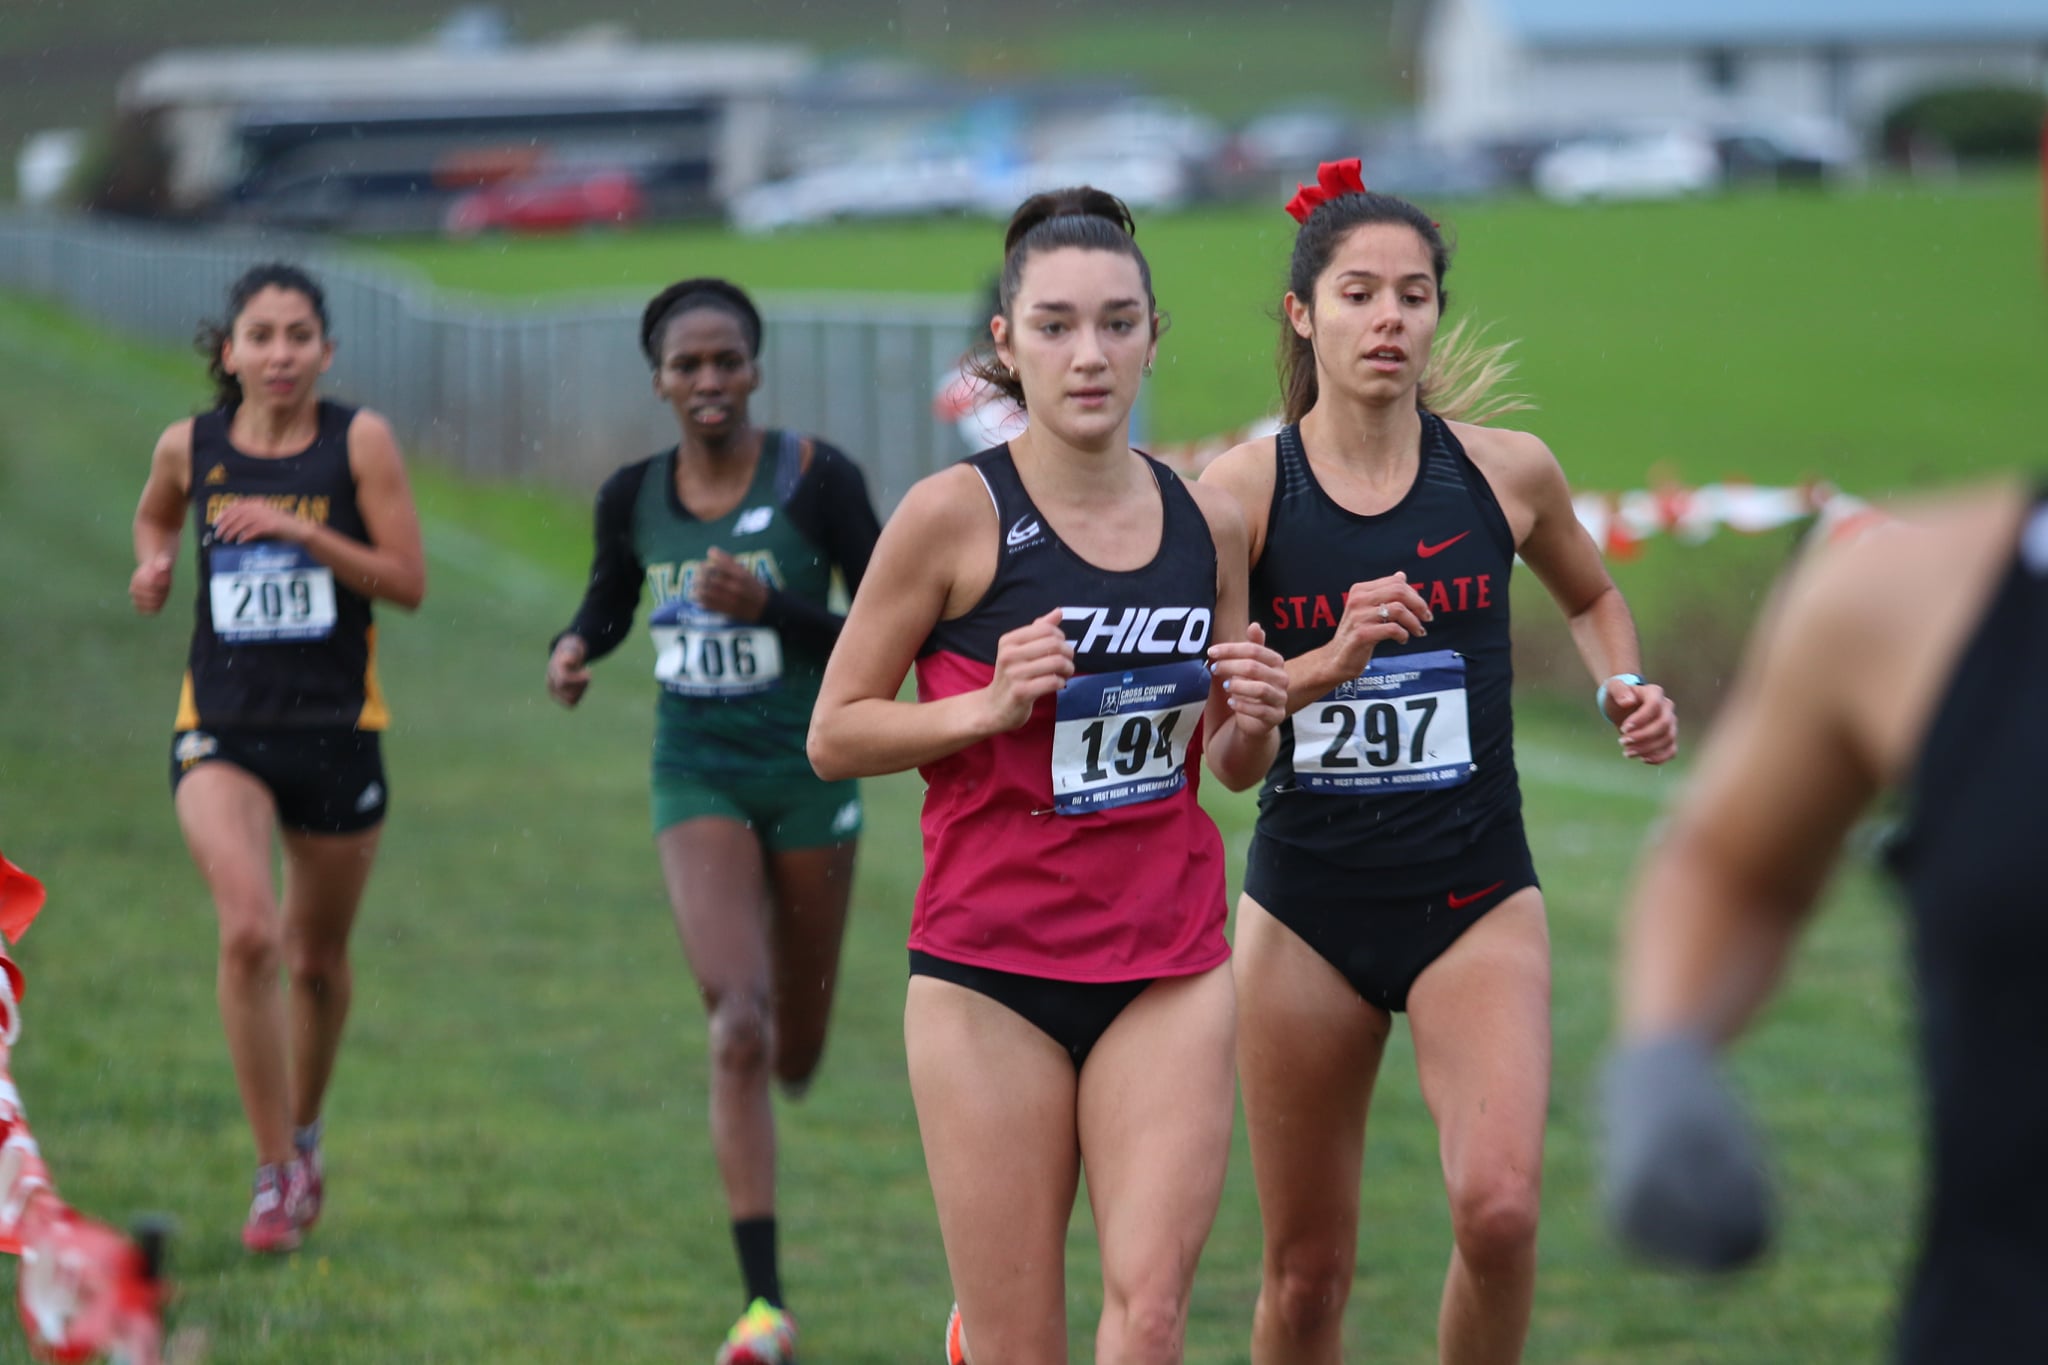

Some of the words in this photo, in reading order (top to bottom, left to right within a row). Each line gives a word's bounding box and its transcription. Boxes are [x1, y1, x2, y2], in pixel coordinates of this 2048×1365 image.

[231, 573, 311, 627] 209
[1272, 591, 1352, 630] STA
[1061, 606, 1211, 654] CHICO
[674, 628, 757, 681] 106
[1120, 687, 1143, 699] CROSS
[1144, 683, 1177, 697] COUNTRY
[1358, 675, 1384, 685] CROSS
[1385, 671, 1421, 683] COUNTRY
[1081, 710, 1181, 783] 194
[1320, 697, 1438, 768] 297
[1092, 791, 1109, 802] WEST
[1110, 786, 1129, 800] REGION
[1333, 778, 1353, 787] WEST
[1354, 777, 1381, 786] REGION
[1391, 772, 1431, 783] NOVEMBER
